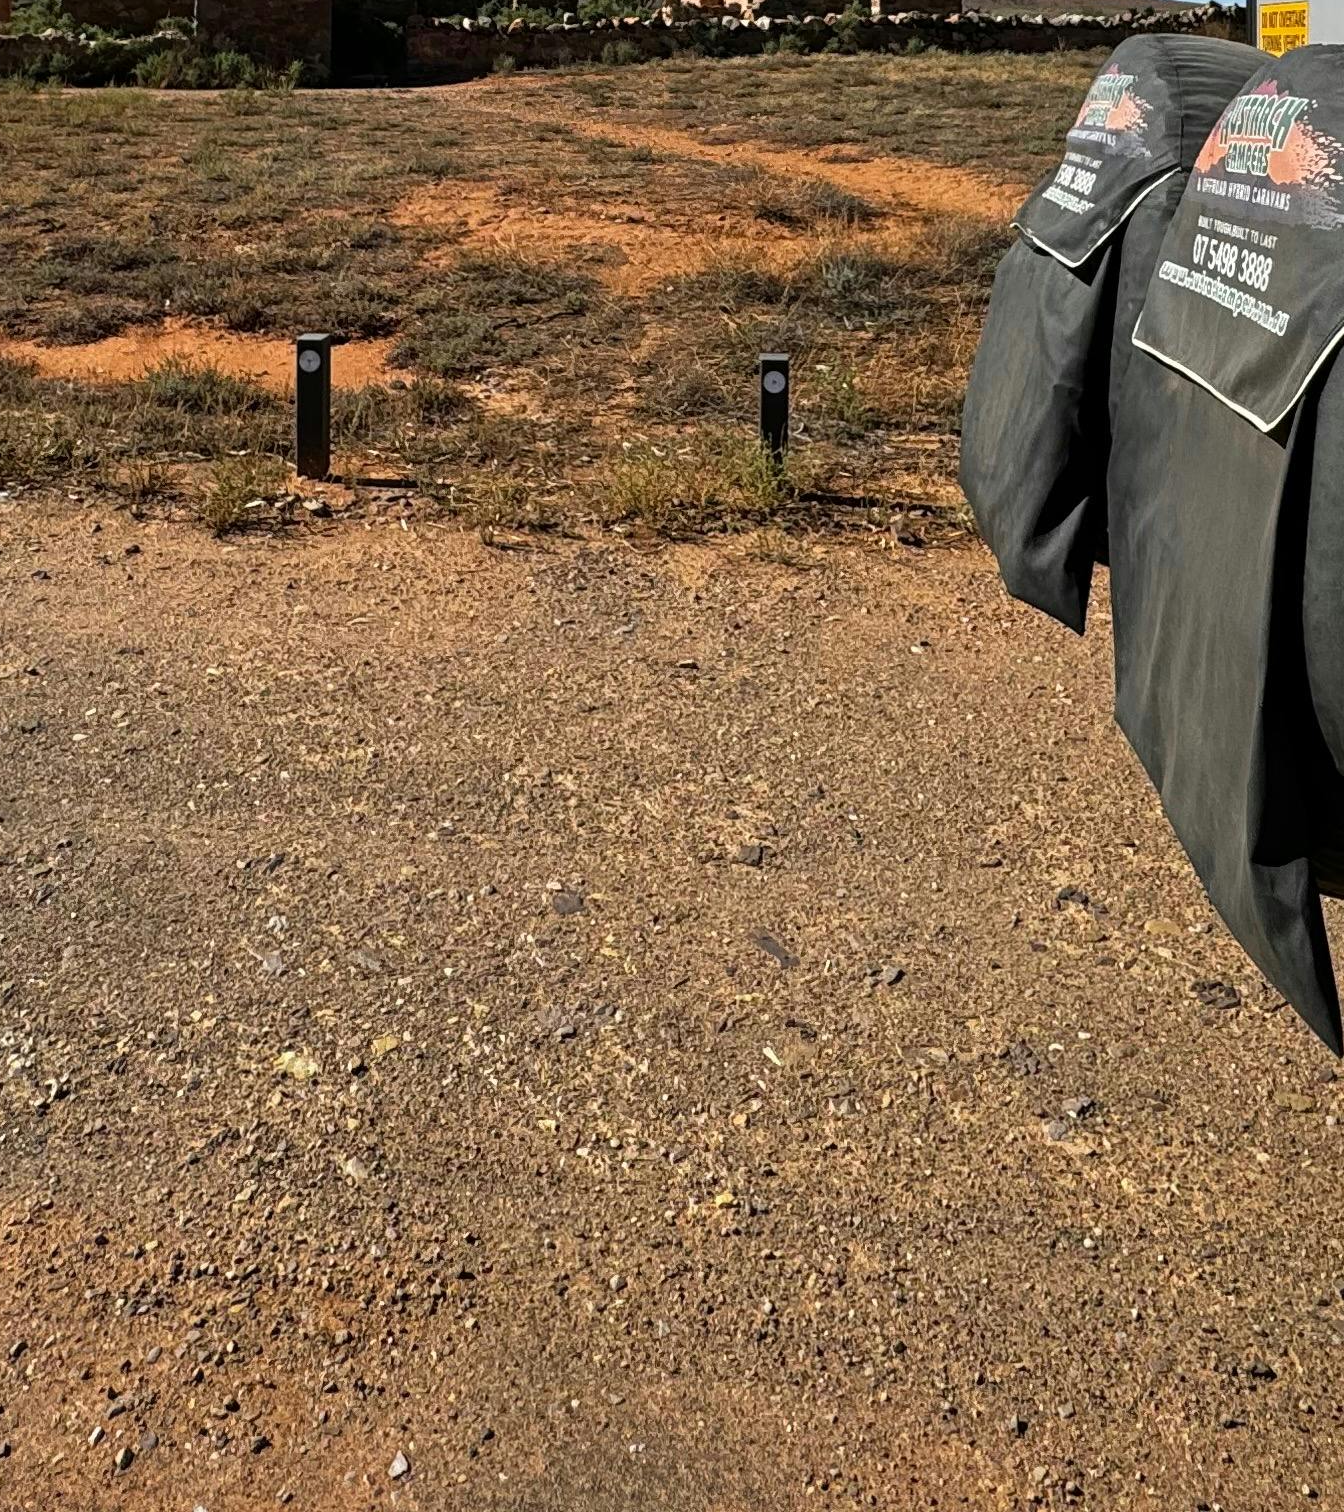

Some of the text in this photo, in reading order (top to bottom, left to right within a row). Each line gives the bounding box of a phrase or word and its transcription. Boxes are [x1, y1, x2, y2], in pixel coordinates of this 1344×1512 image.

[1225, 141, 1271, 176] CAMPERS
[1252, 187, 1291, 212] CARAVANS
[1260, 233, 1278, 249] LAST
[1193, 234, 1273, 292] 07 5498 3888
